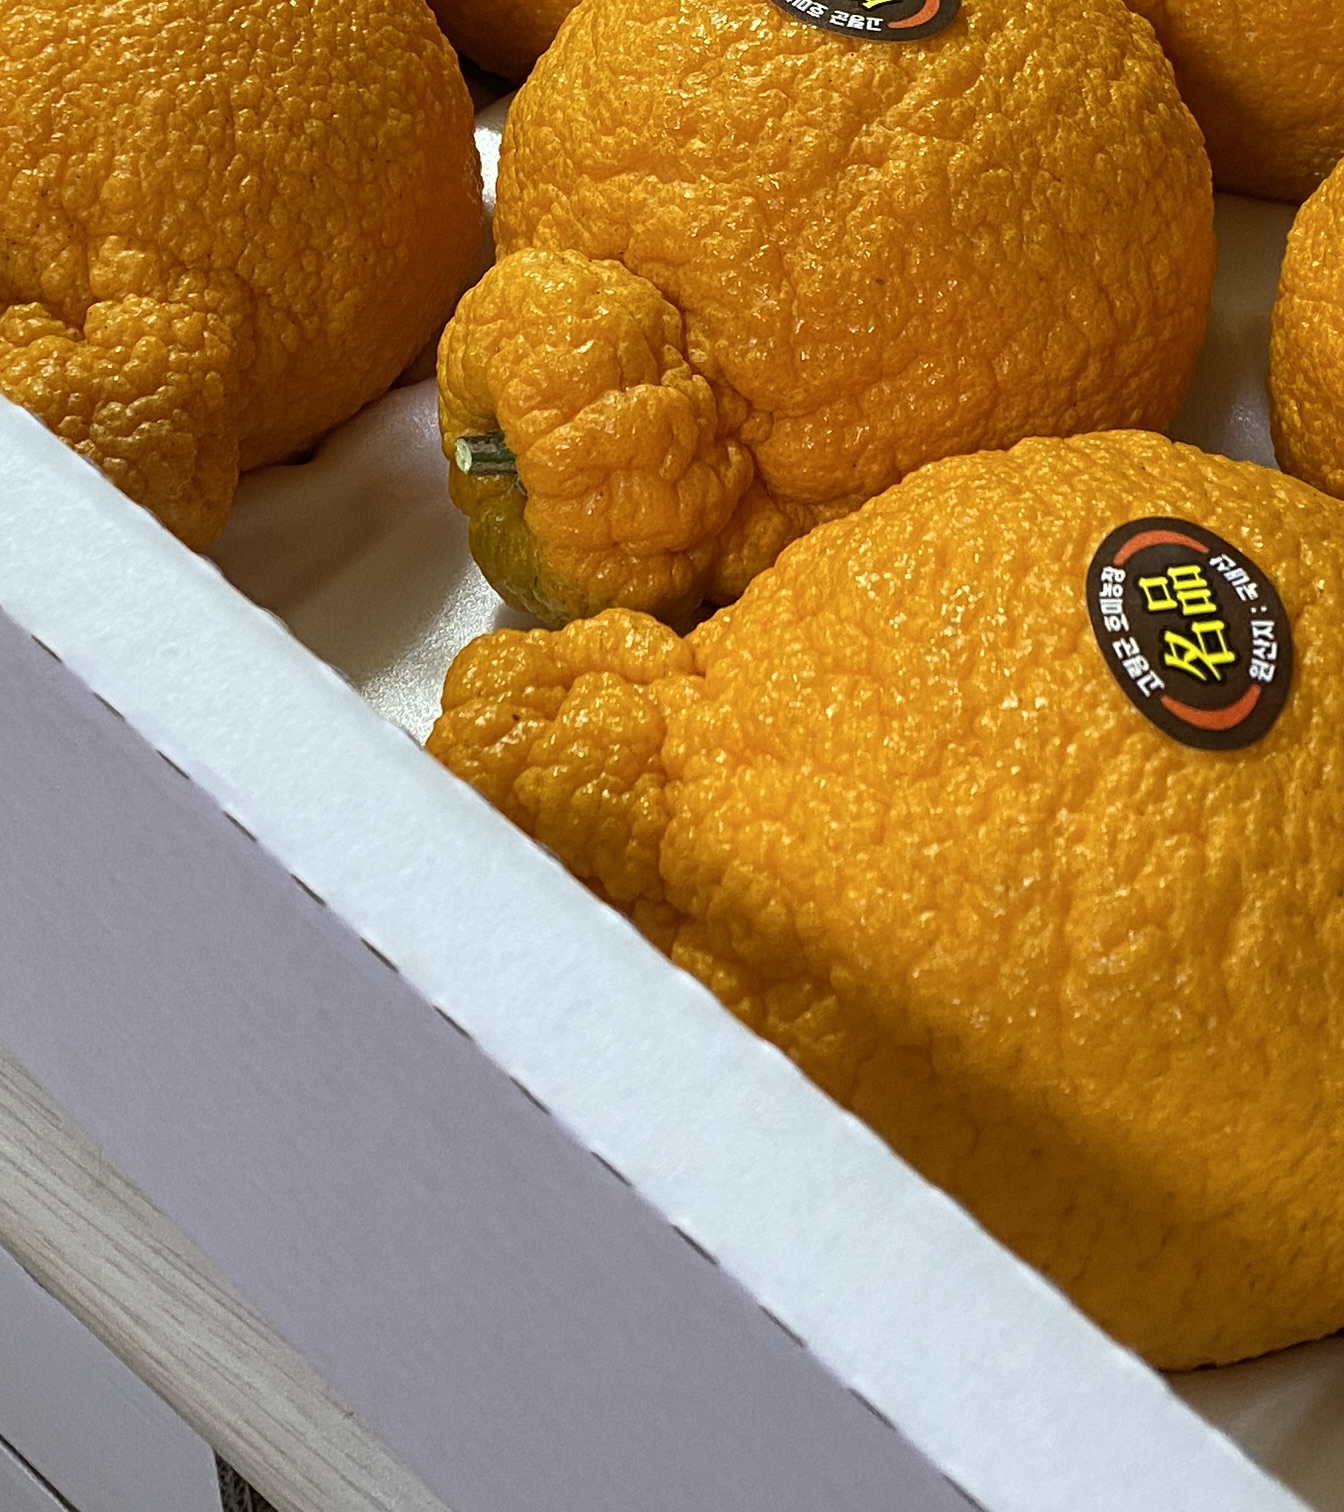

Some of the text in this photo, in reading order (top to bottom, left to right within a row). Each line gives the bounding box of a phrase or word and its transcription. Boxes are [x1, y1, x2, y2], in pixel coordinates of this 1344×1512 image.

[830, 10, 884, 32] 고령군
[1209, 554, 1258, 601] 국내산
[1099, 566, 1165, 696] 고령군 호미농장
[1138, 565, 1235, 681] 名品
[1250, 619, 1278, 682] 원산지
